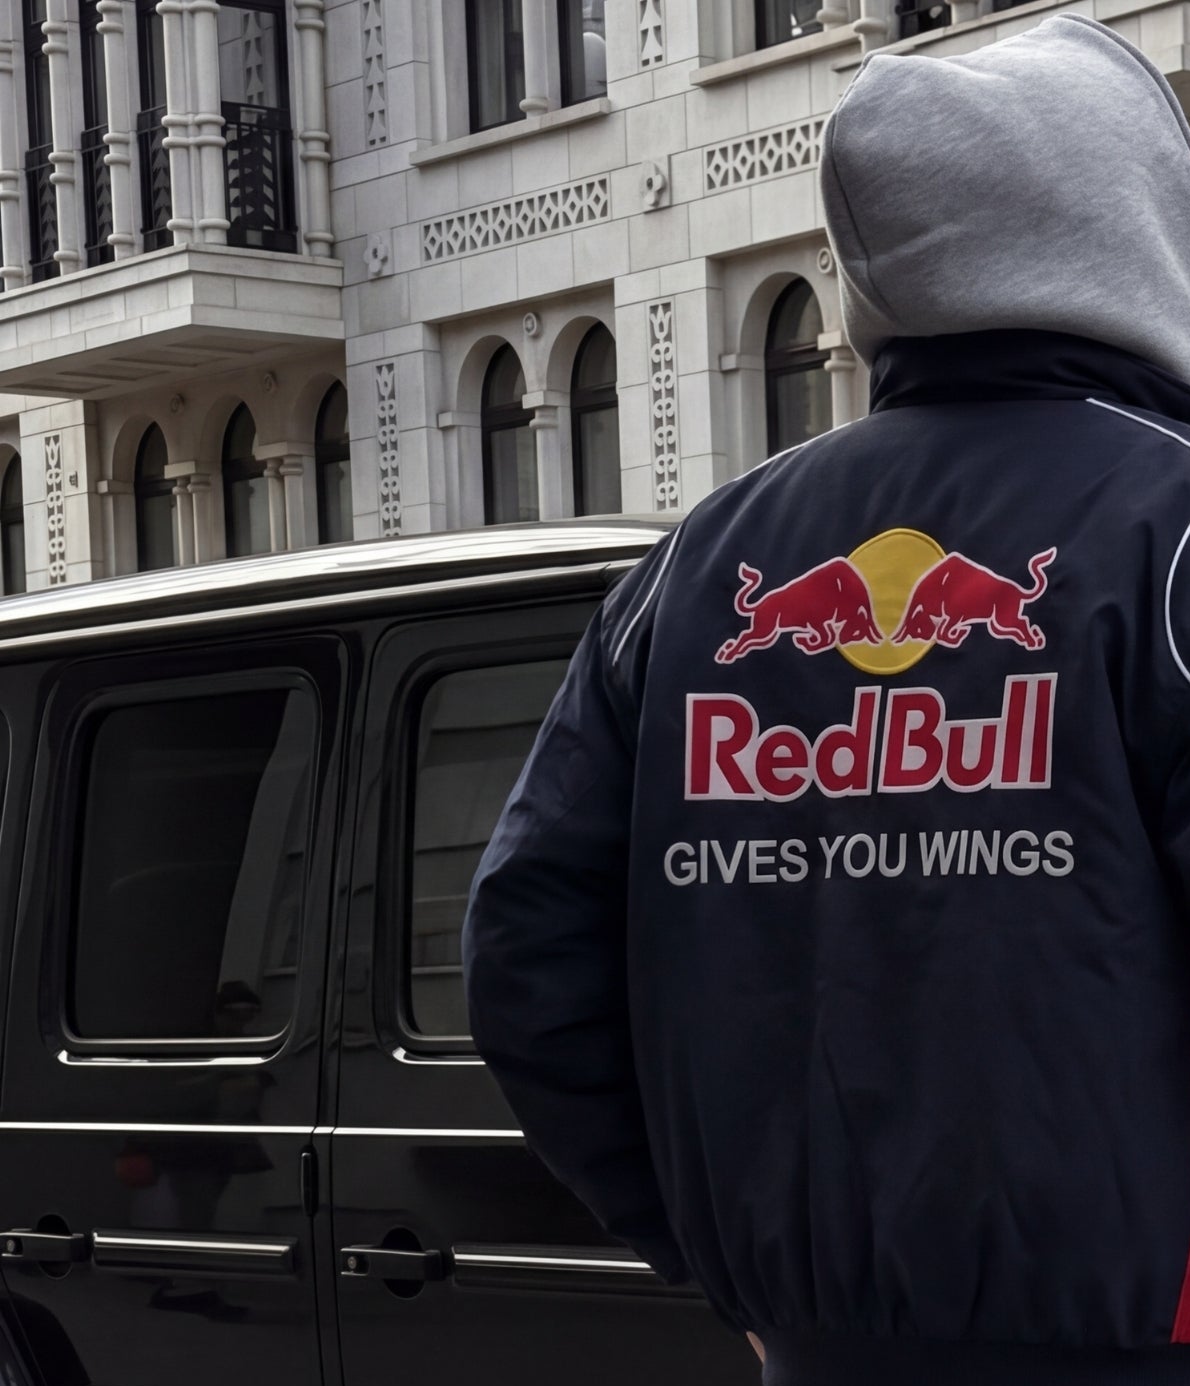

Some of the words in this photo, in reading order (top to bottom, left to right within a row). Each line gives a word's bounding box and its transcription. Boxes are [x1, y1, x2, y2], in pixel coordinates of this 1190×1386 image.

[663, 839, 808, 886] GIVES
[818, 833, 907, 879] YOU
[918, 830, 1075, 877] WINGS
